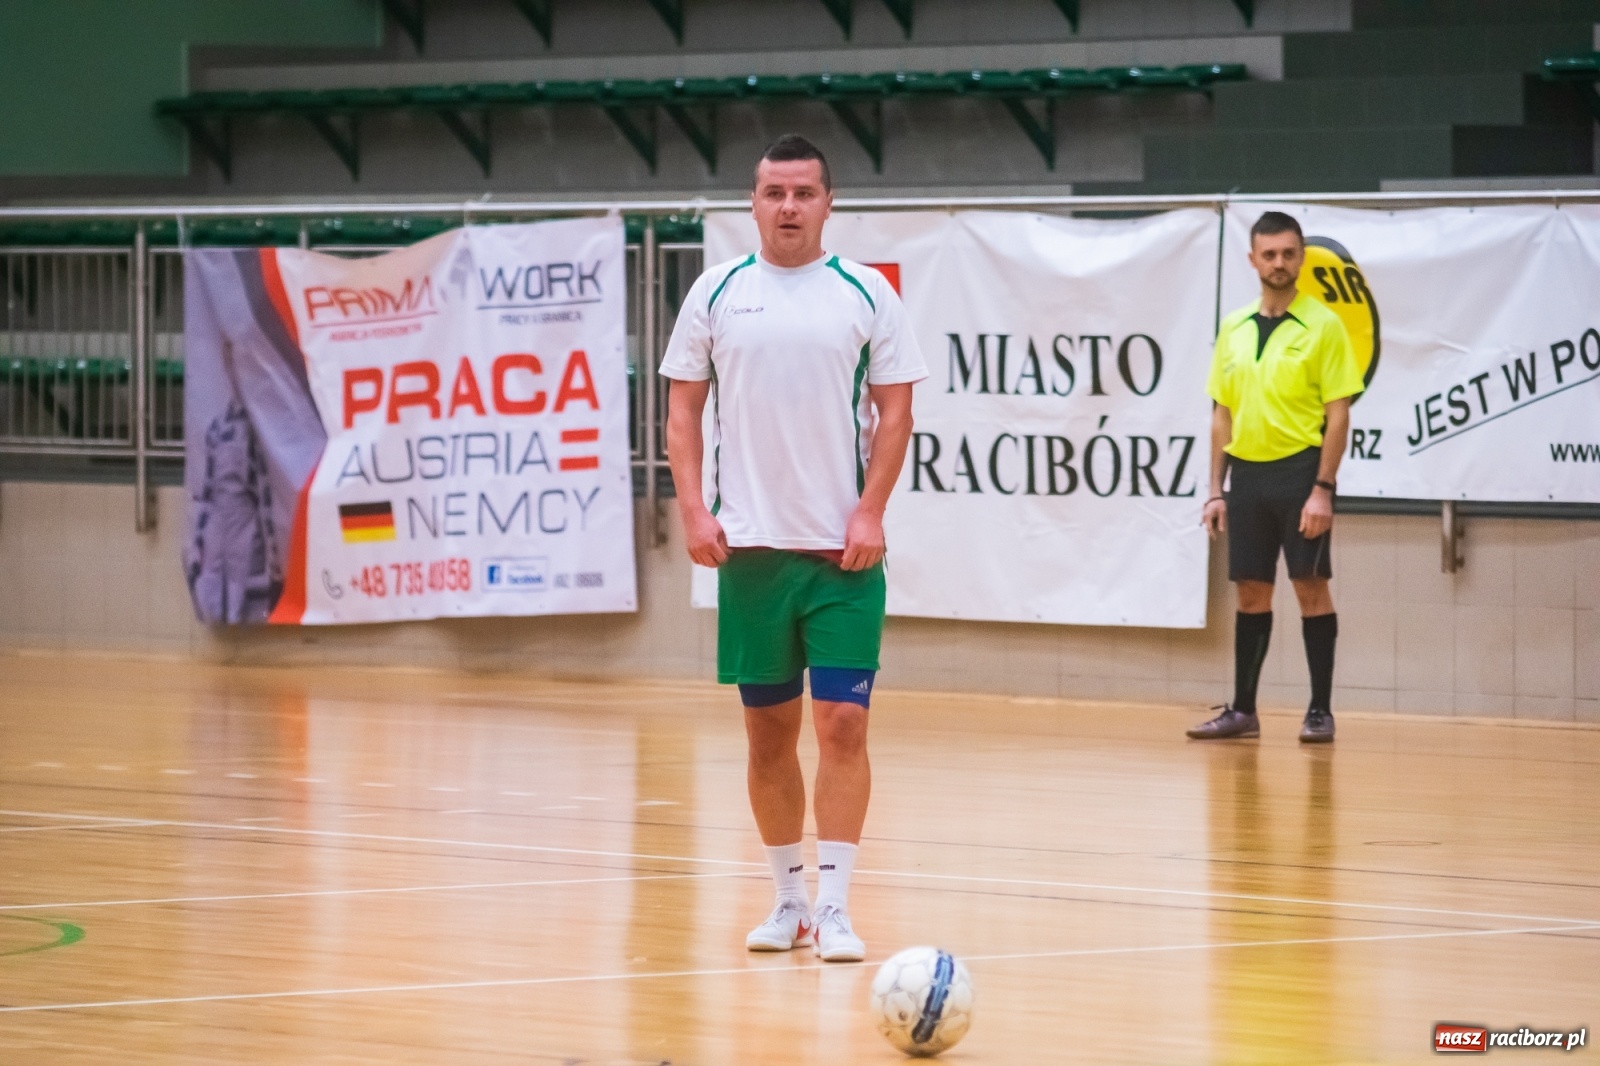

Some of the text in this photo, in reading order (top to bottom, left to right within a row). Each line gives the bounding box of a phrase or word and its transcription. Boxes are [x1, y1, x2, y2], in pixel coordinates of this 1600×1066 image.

[480, 260, 602, 300] WORK
[343, 350, 600, 429] PRACA
[945, 333, 1163, 397] MIASTO
[1407, 328, 1600, 447] JEST W PO
[336, 431, 552, 488] AUSTRIA
[909, 415, 1197, 497] RACIBÓRZ
